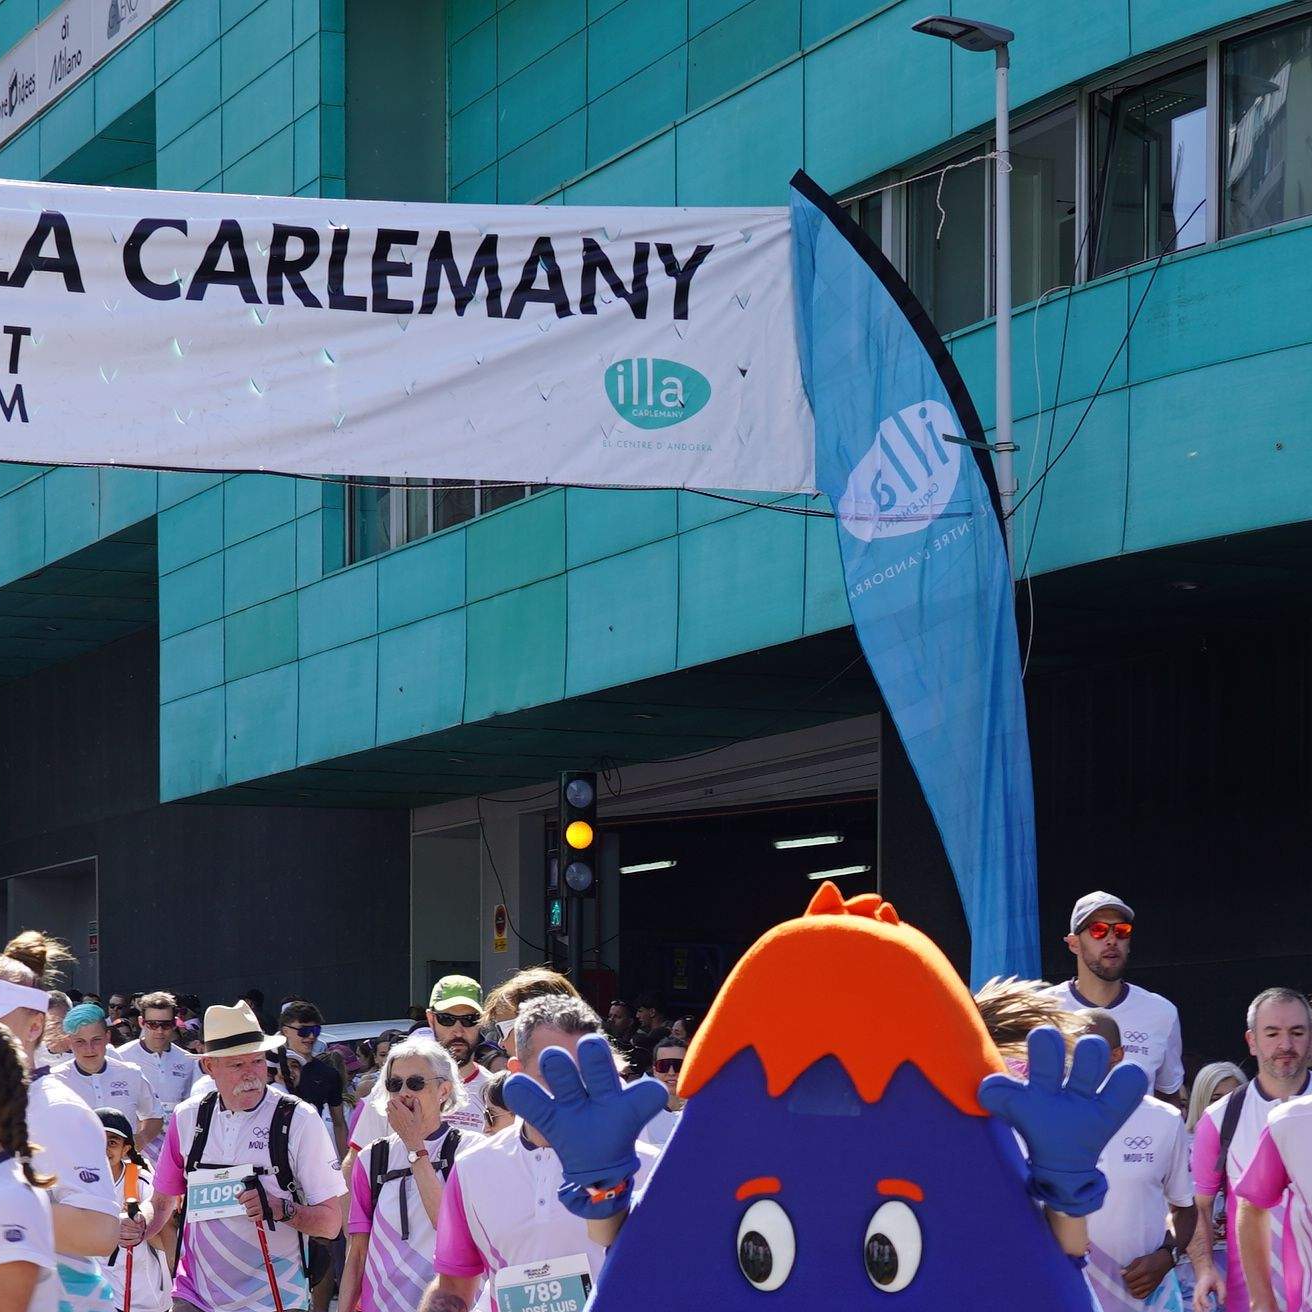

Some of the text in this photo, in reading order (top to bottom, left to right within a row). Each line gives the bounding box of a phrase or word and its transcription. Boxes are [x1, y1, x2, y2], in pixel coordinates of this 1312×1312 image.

[124, 217, 715, 321] CARLEMANY
[617, 358, 685, 408] illa
[632, 409, 683, 418] CARLEMANY
[603, 440, 613, 448] EL
[617, 440, 653, 450] CENTRE
[1123, 1152, 1154, 1163] MOU-TE
[524, 1280, 562, 1304] 789
